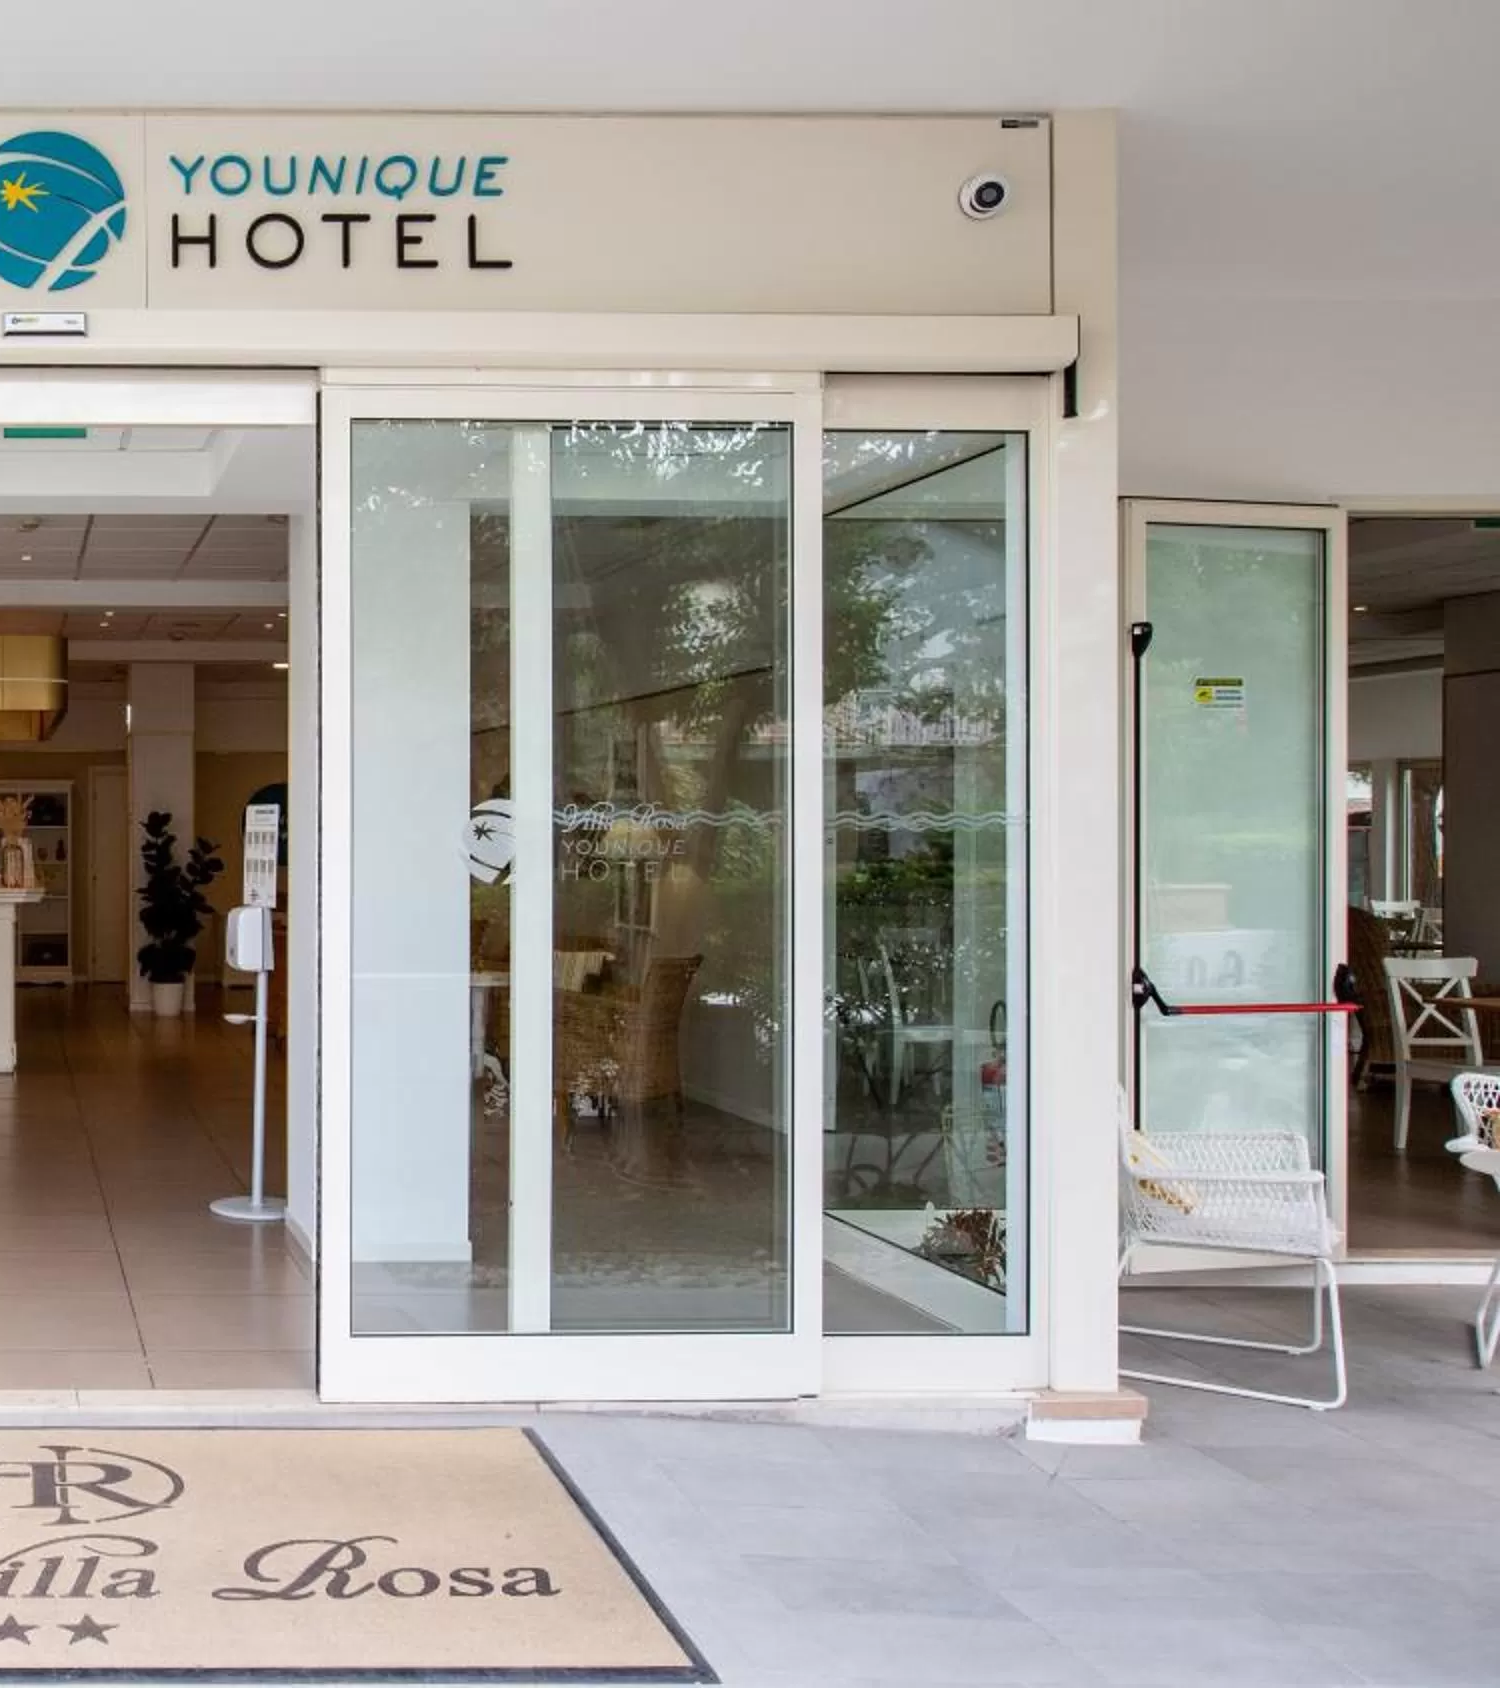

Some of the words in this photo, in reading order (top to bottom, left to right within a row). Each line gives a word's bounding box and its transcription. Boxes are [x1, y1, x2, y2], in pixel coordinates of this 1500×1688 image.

[169, 155, 509, 200] YOUNIQUE
[172, 213, 513, 269] HOTEL
[562, 839, 686, 856] YOUNIQUE
[562, 860, 689, 882] HOTEL
[212, 1535, 562, 1601] Rosa
